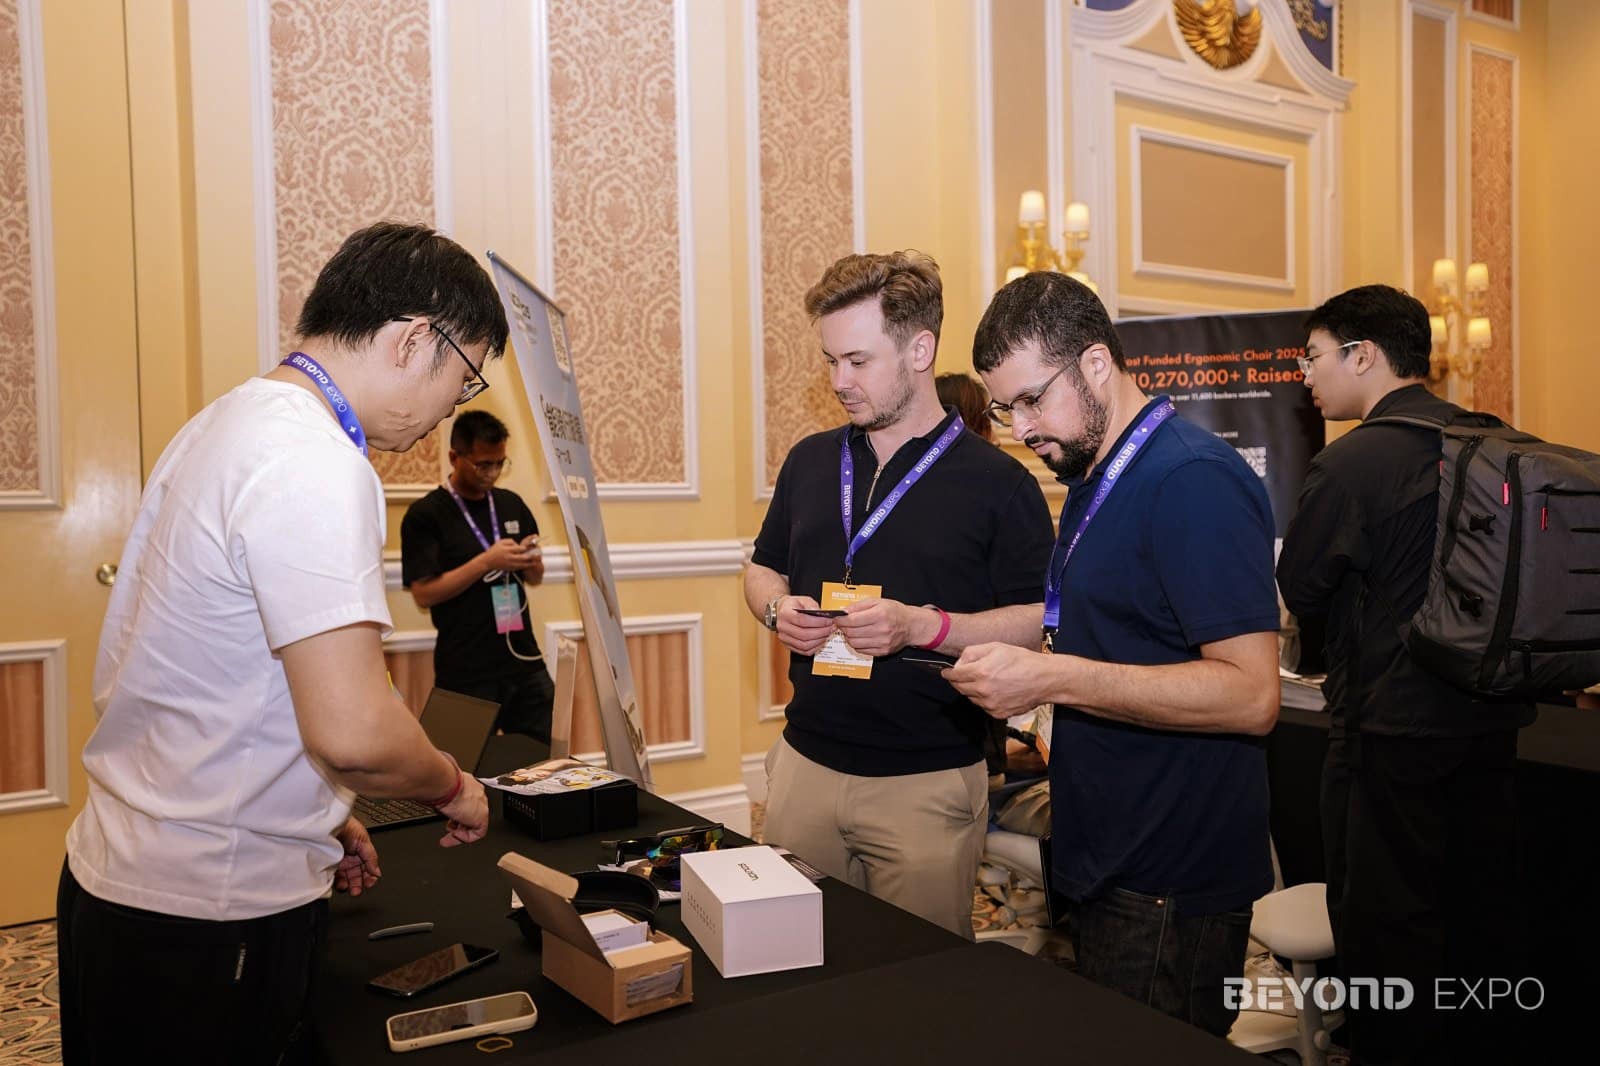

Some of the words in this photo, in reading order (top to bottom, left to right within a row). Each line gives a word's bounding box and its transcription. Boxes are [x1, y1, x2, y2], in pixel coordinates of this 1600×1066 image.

[1126, 356, 1140, 367] ost
[1144, 353, 1181, 366] Funded
[1184, 350, 1240, 366] Ergonomic
[1243, 349, 1272, 361] Chair
[1275, 347, 1305, 360] 2025
[292, 355, 328, 385] BEYOND
[326, 386, 347, 412] EXPO
[914, 446, 940, 473] BEYOND
[937, 433, 952, 449] EXPO
[1107, 442, 1137, 480] BEYOND
[843, 484, 851, 516] BEYOND
[861, 507, 886, 538] BEYOND
[883, 490, 900, 509] EXPO
